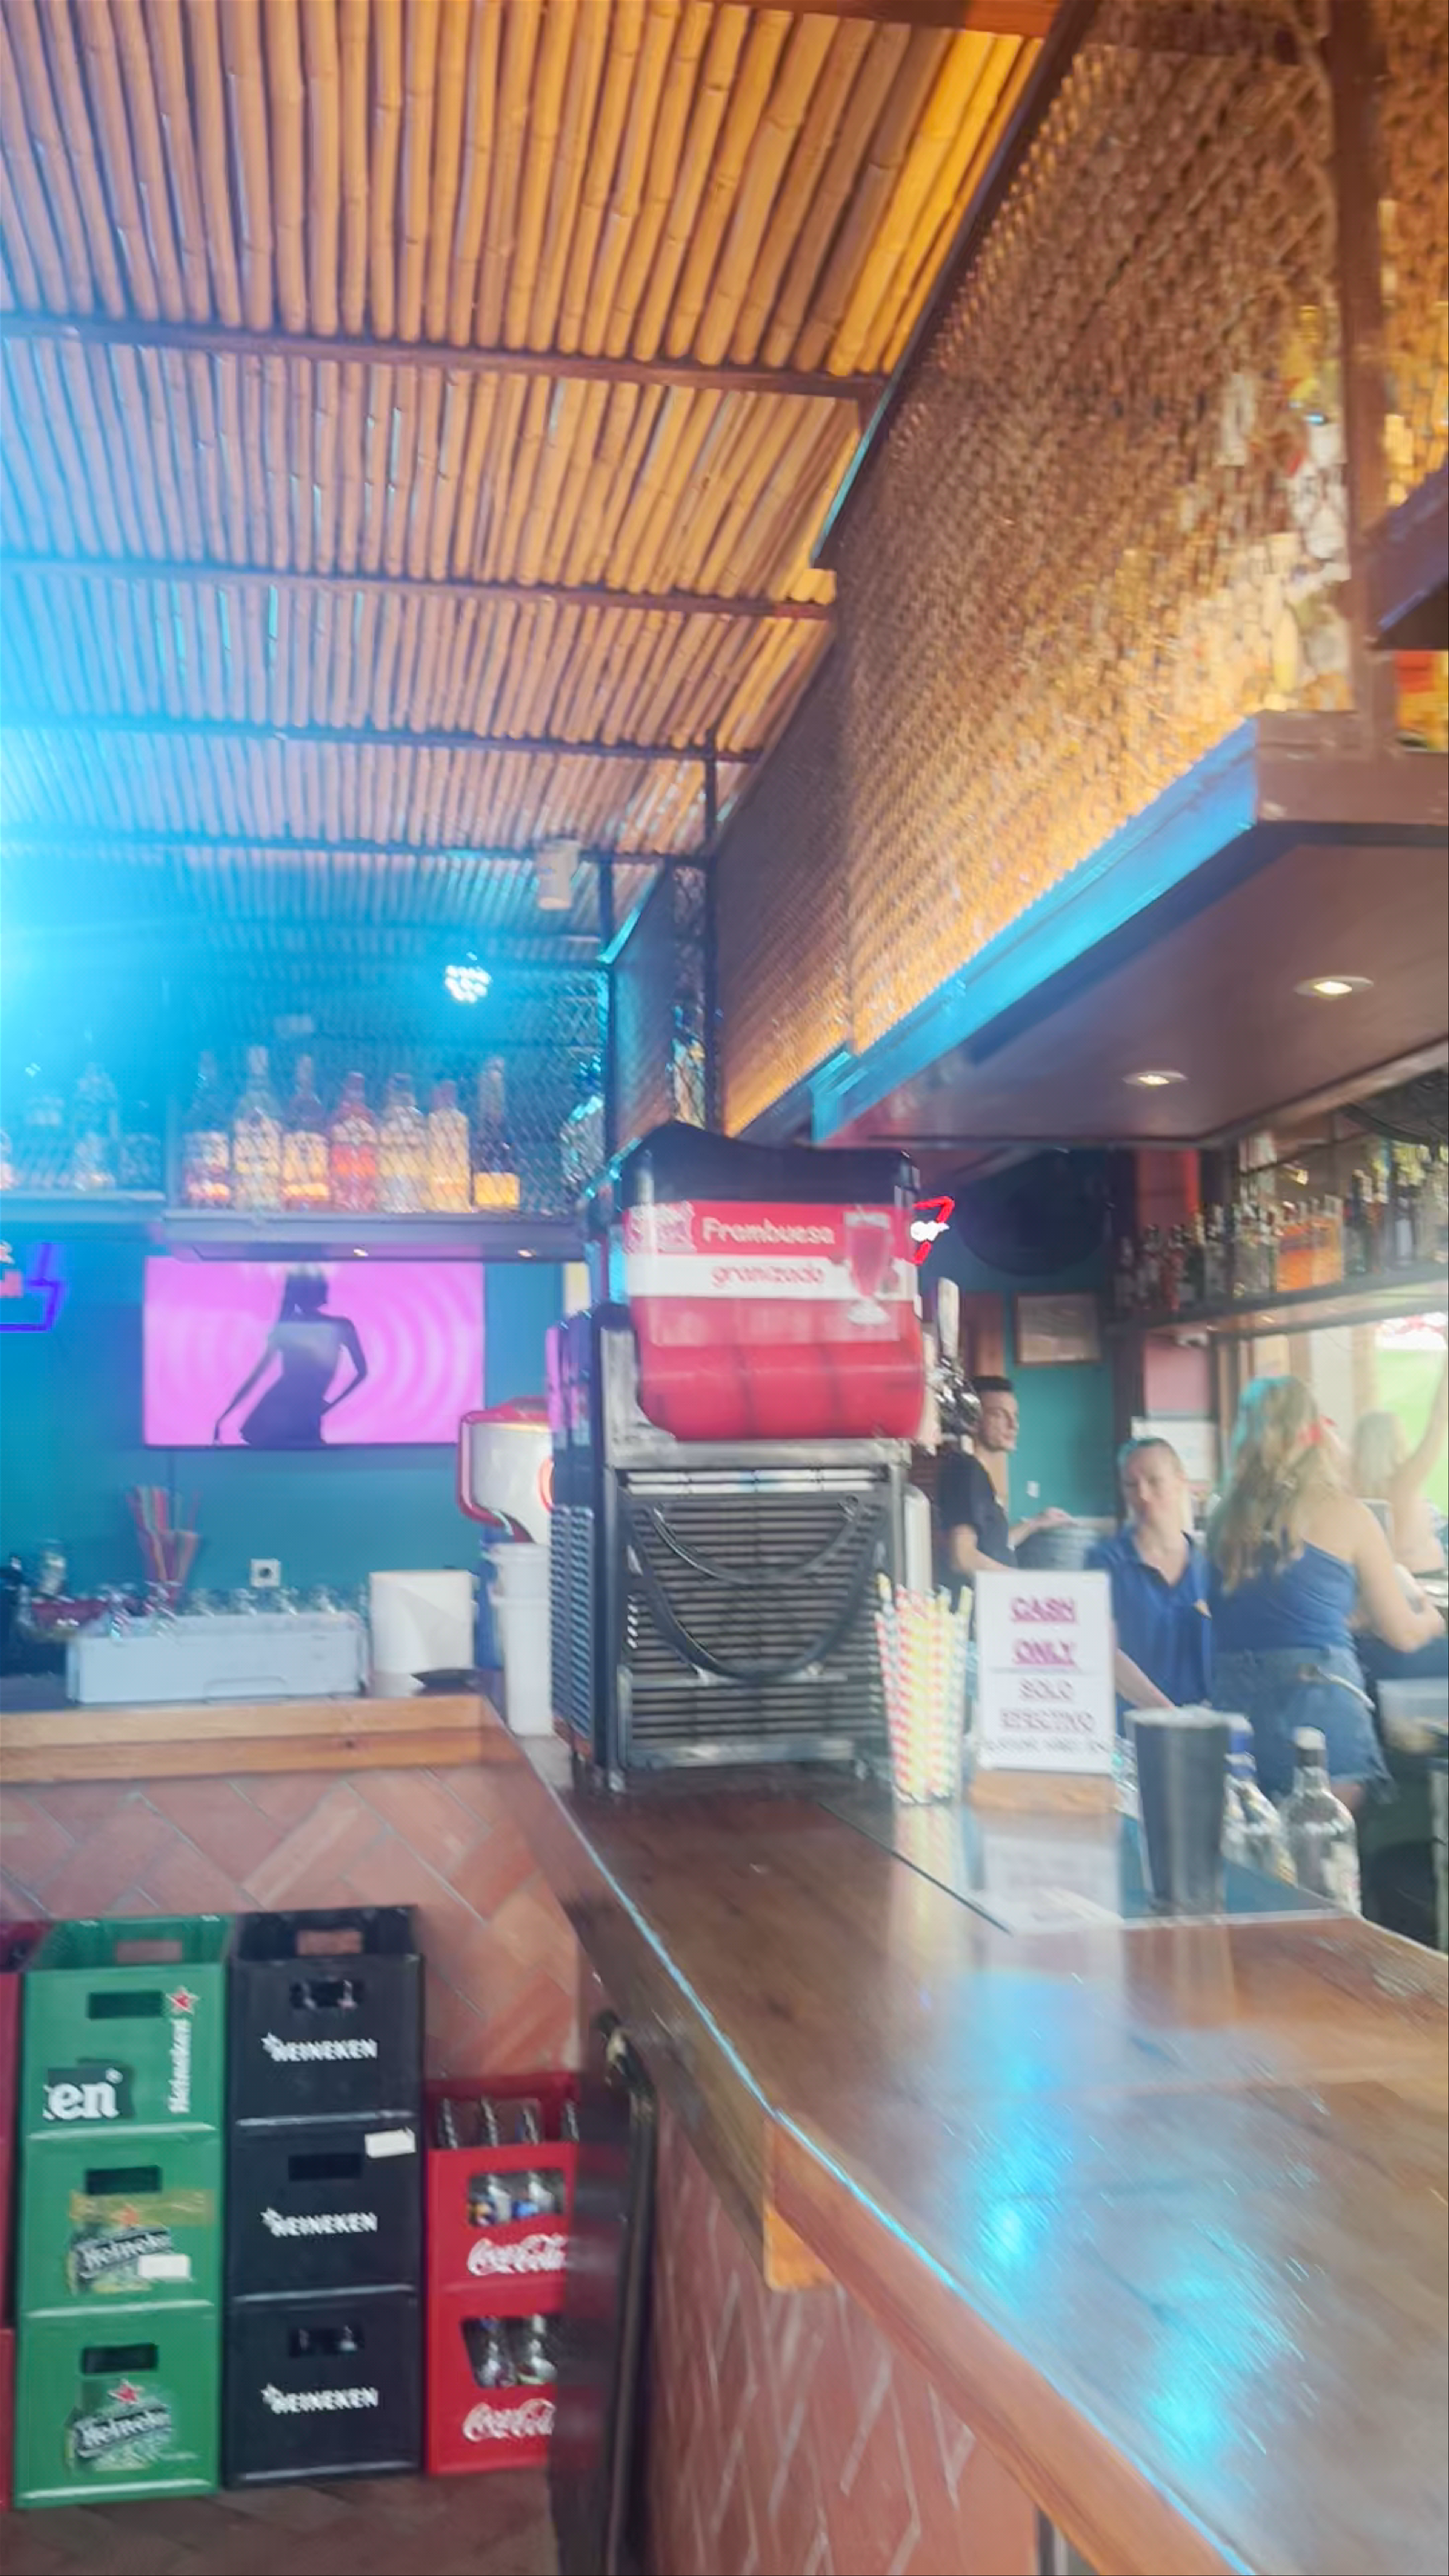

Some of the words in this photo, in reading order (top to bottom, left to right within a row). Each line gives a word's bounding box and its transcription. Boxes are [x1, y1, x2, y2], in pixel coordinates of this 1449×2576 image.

[702, 1217, 835, 1244] Frambuesa
[711, 1265, 826, 1288] granizado
[1011, 1596, 1075, 1622] CASH
[1013, 1639, 1077, 1665] ONLY
[42, 2082, 120, 2120] en
